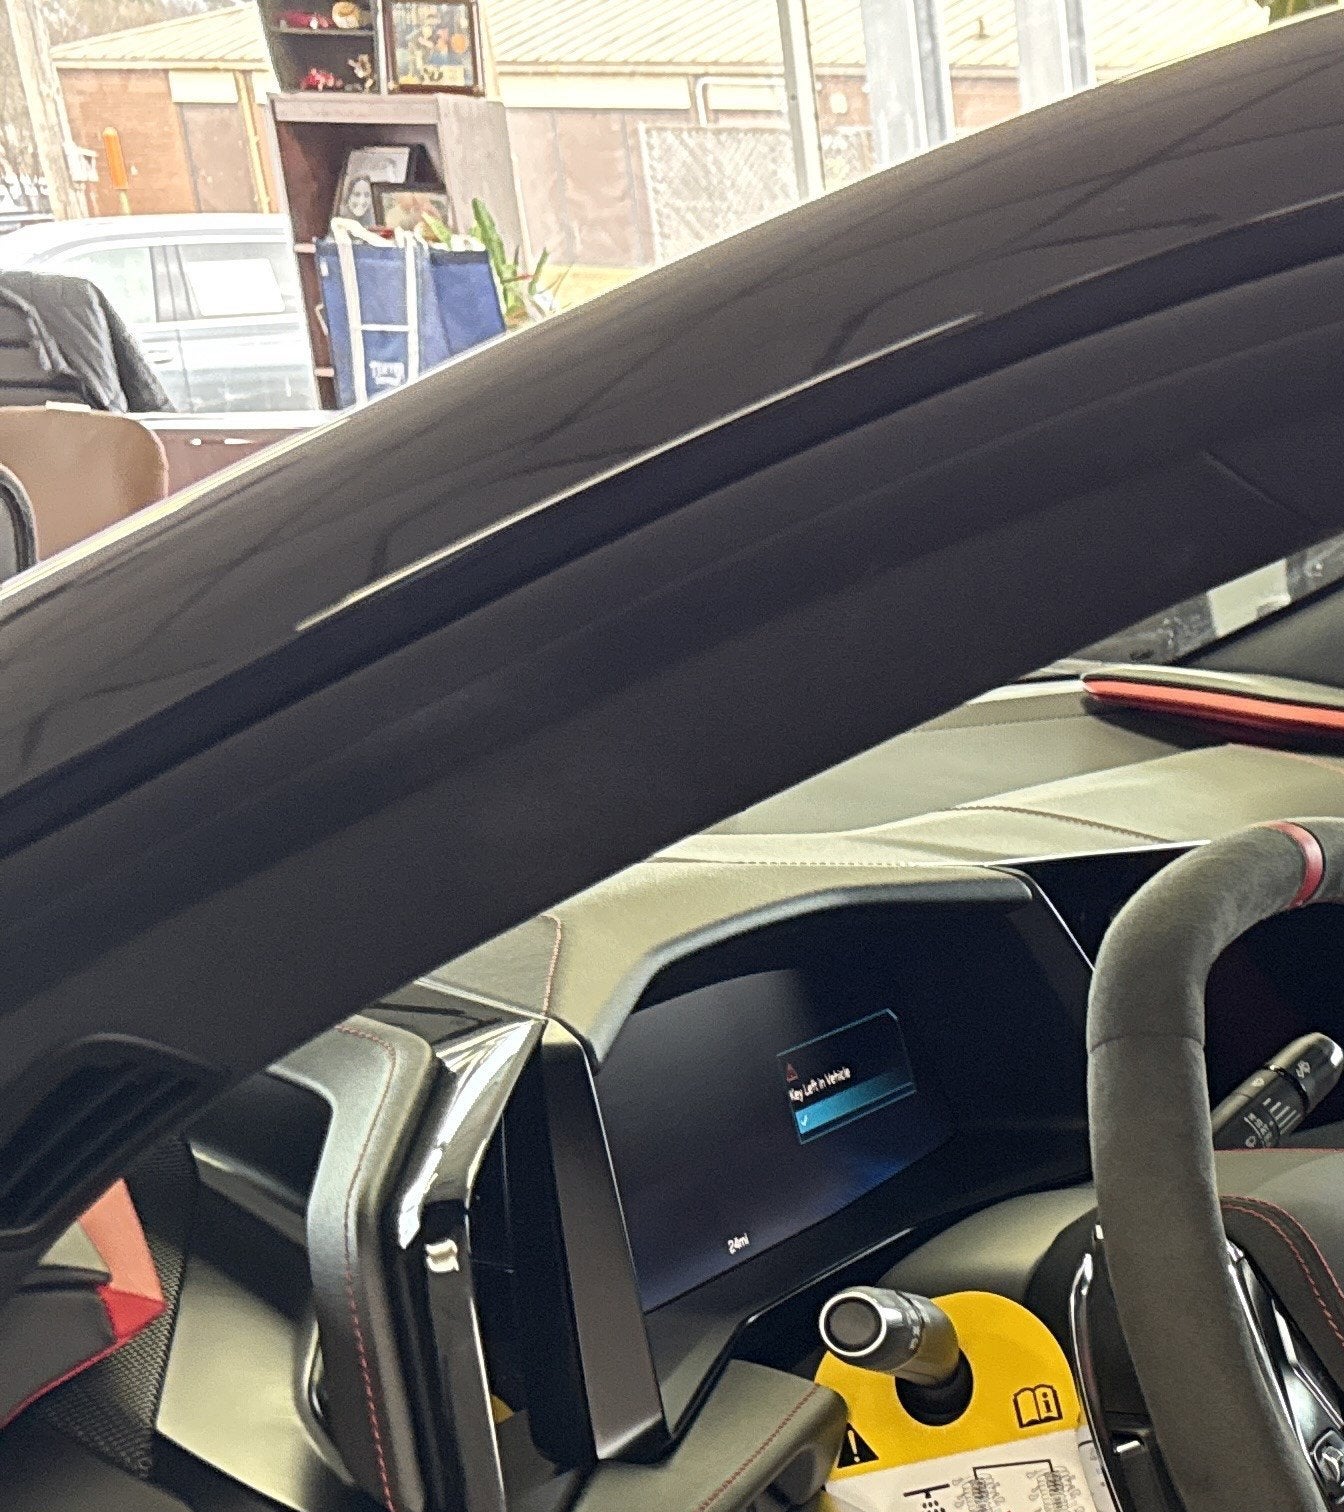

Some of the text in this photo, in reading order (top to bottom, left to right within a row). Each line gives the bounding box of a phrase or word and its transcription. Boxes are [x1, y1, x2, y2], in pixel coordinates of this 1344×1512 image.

[788, 1087, 804, 1103] Key
[802, 1078, 818, 1096] Left
[824, 1066, 851, 1086] Vehicle
